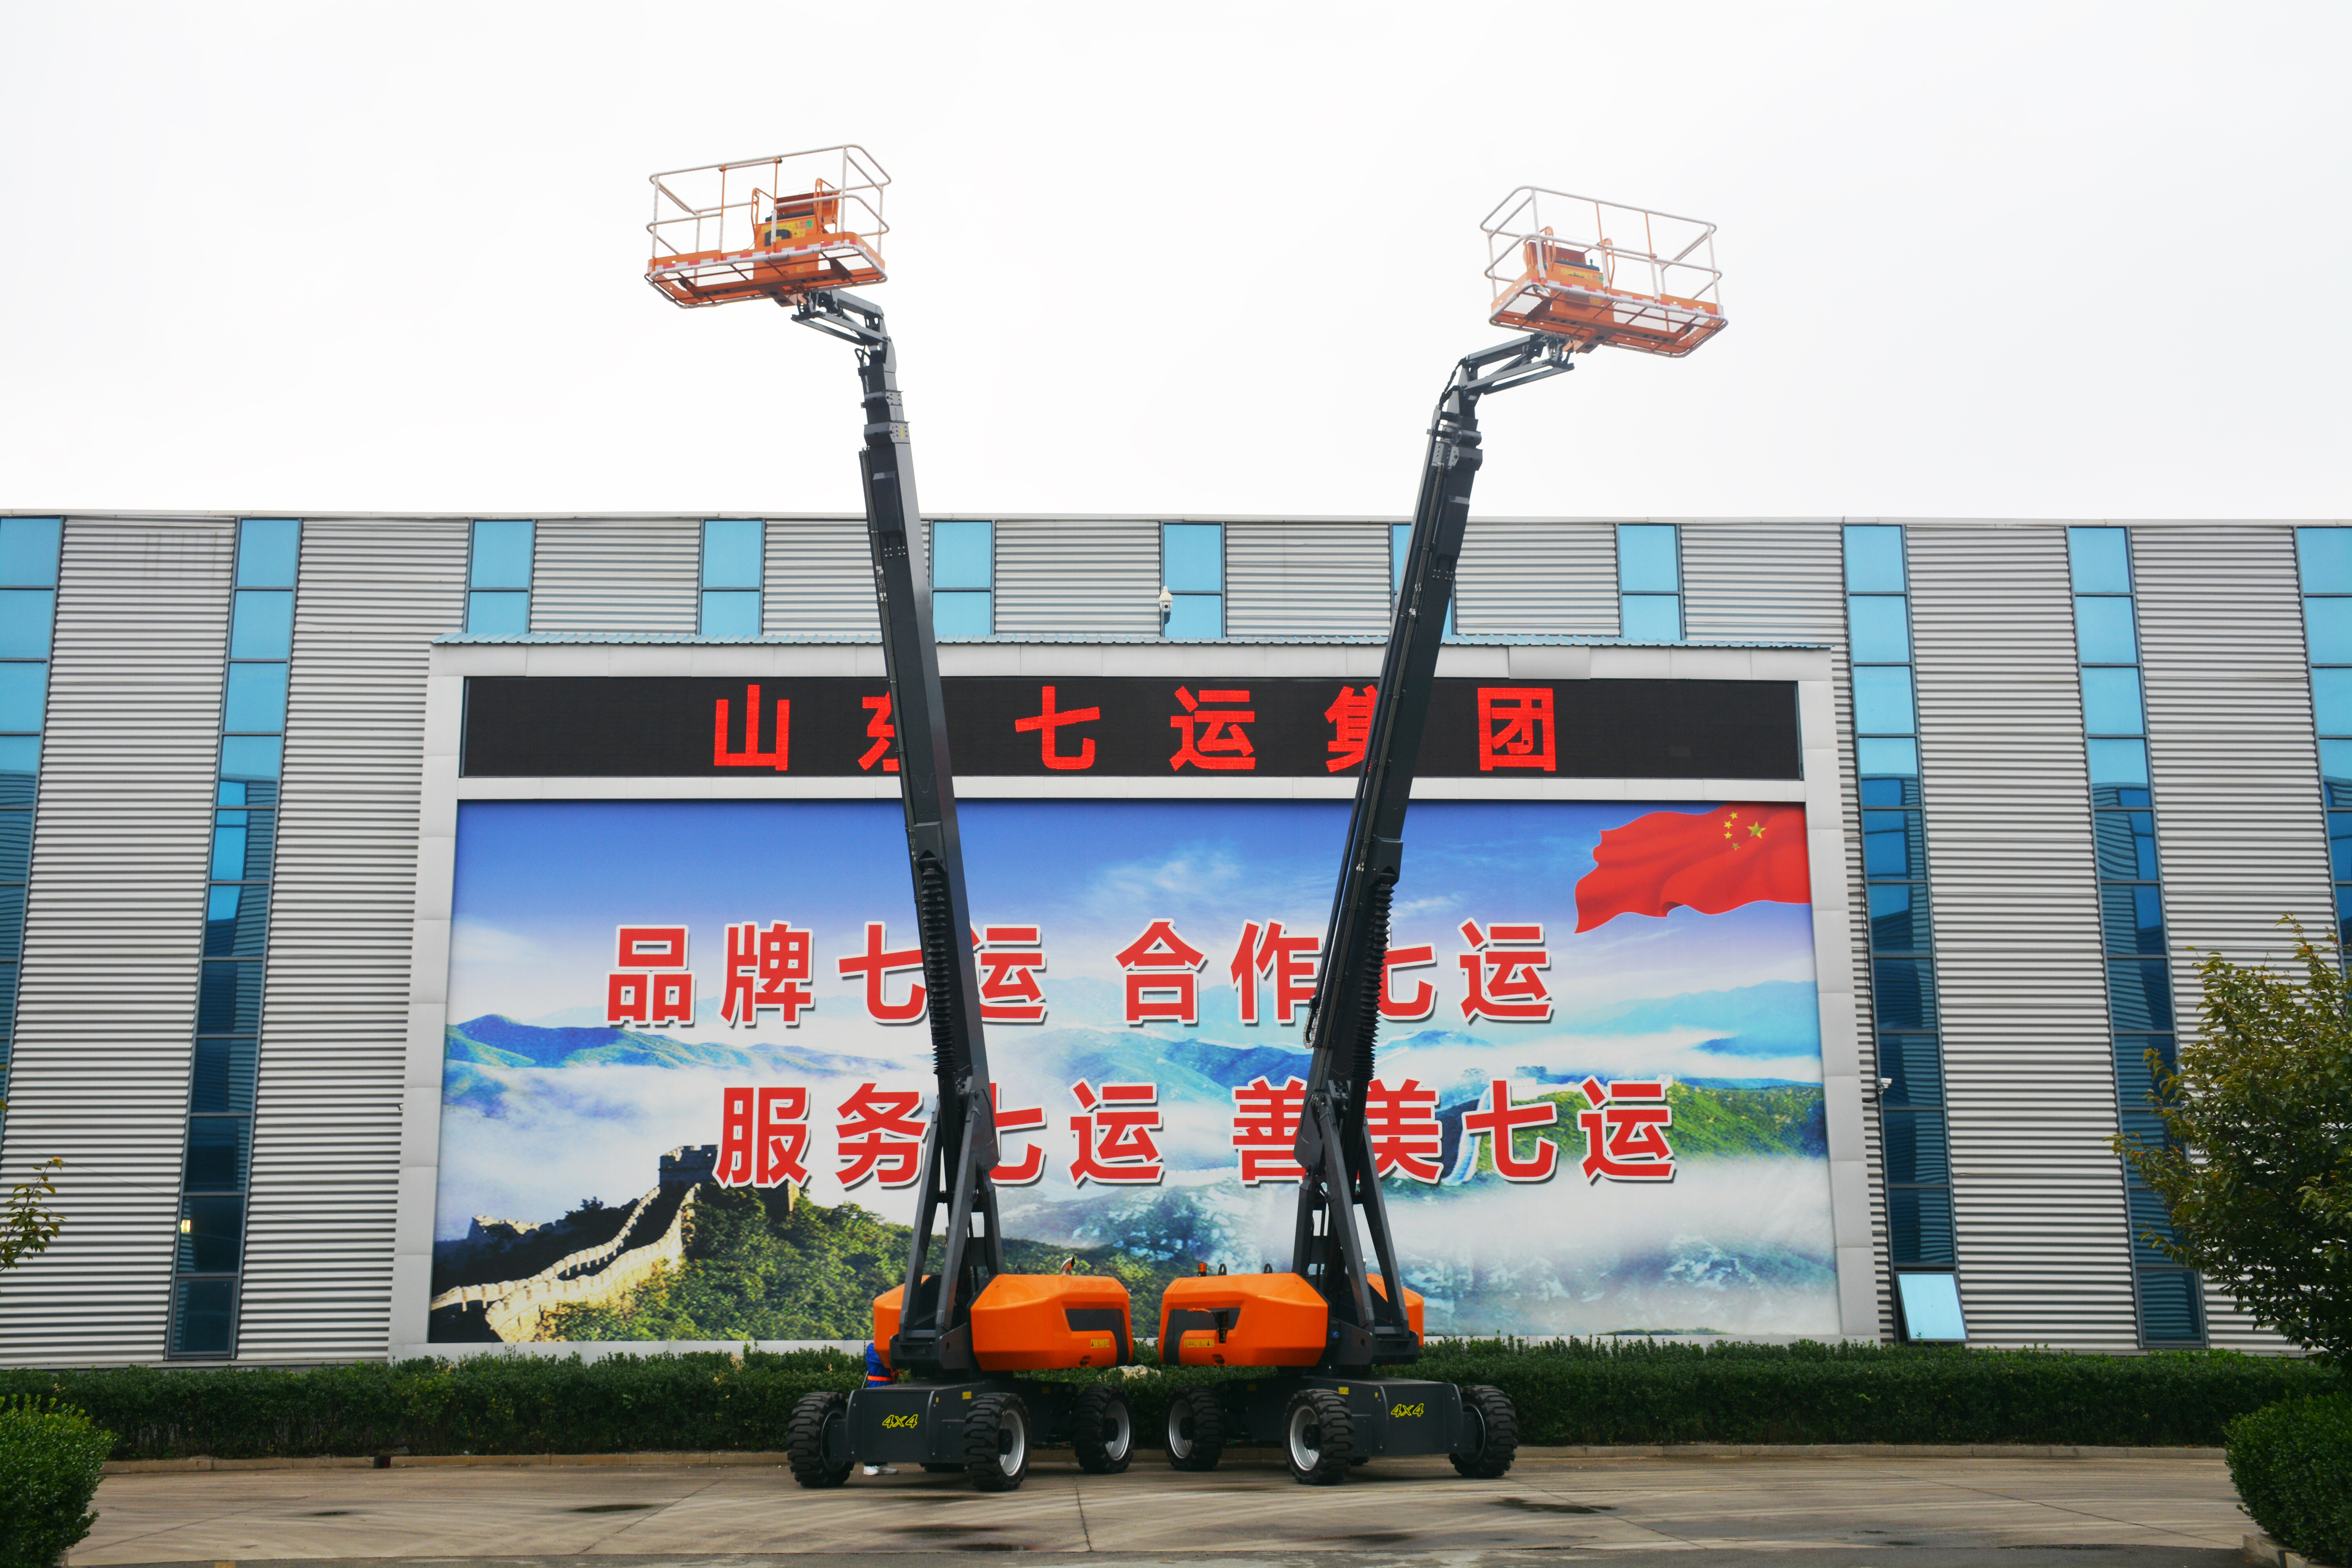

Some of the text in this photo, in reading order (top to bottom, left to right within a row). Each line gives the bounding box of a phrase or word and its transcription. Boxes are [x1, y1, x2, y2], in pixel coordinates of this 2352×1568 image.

[606, 921, 1045, 1023] 品牌七运
[1231, 1077, 1673, 1182] 善美七运
